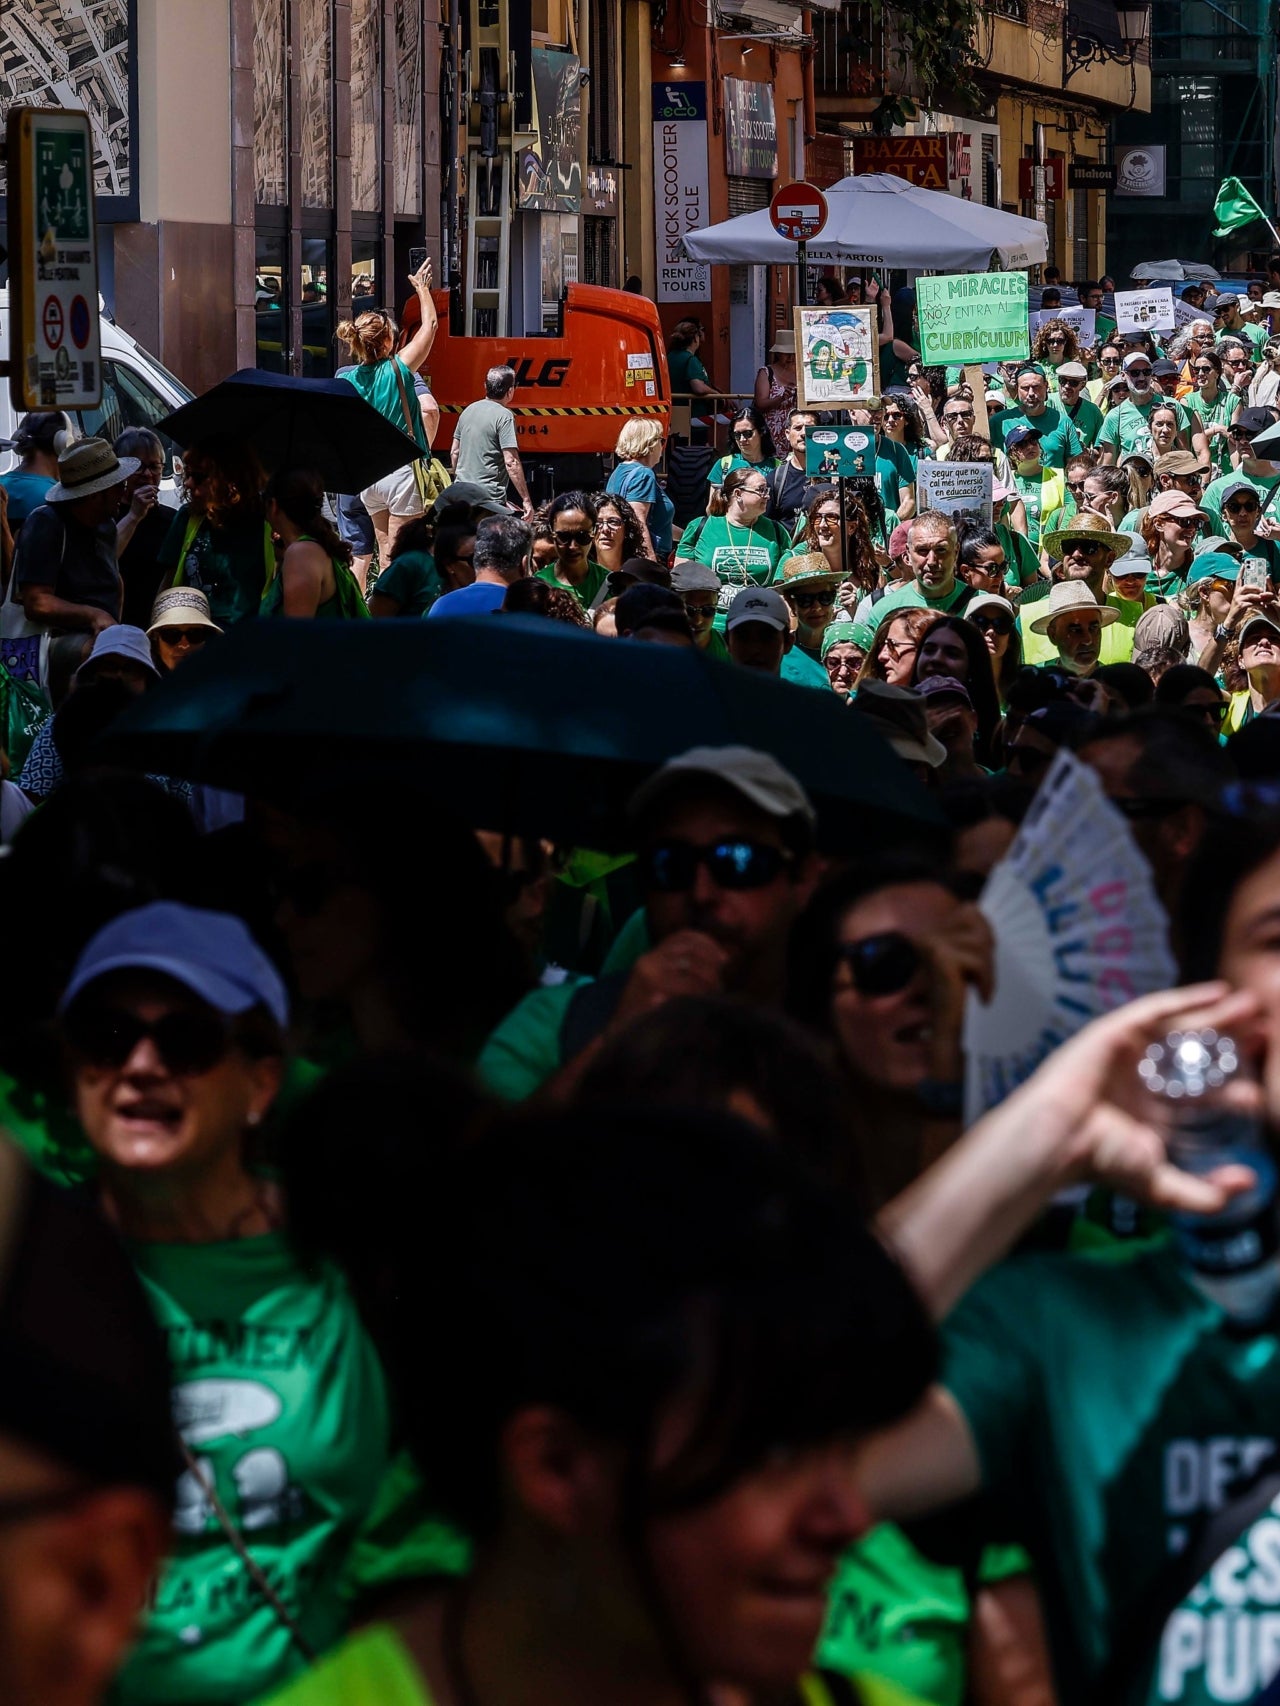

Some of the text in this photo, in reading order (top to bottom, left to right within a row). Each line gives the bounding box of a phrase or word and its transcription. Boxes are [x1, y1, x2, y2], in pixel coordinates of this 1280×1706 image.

[864, 139, 944, 159] BAZAR
[1074, 168, 1112, 179] Mahou
[662, 123, 680, 264] EKICK SCOOTER
[845, 253, 884, 263] ARTOIS
[662, 268, 693, 278] RENT
[662, 281, 706, 291] TOURS
[926, 300, 1012, 320] NO ENTRA AL
[926, 325, 1029, 351] CURRÍCULUM
[955, 468, 969, 478] que
[970, 467, 980, 475] no
[929, 476, 984, 488] cal més inversió
[935, 485, 983, 497] en educació?
